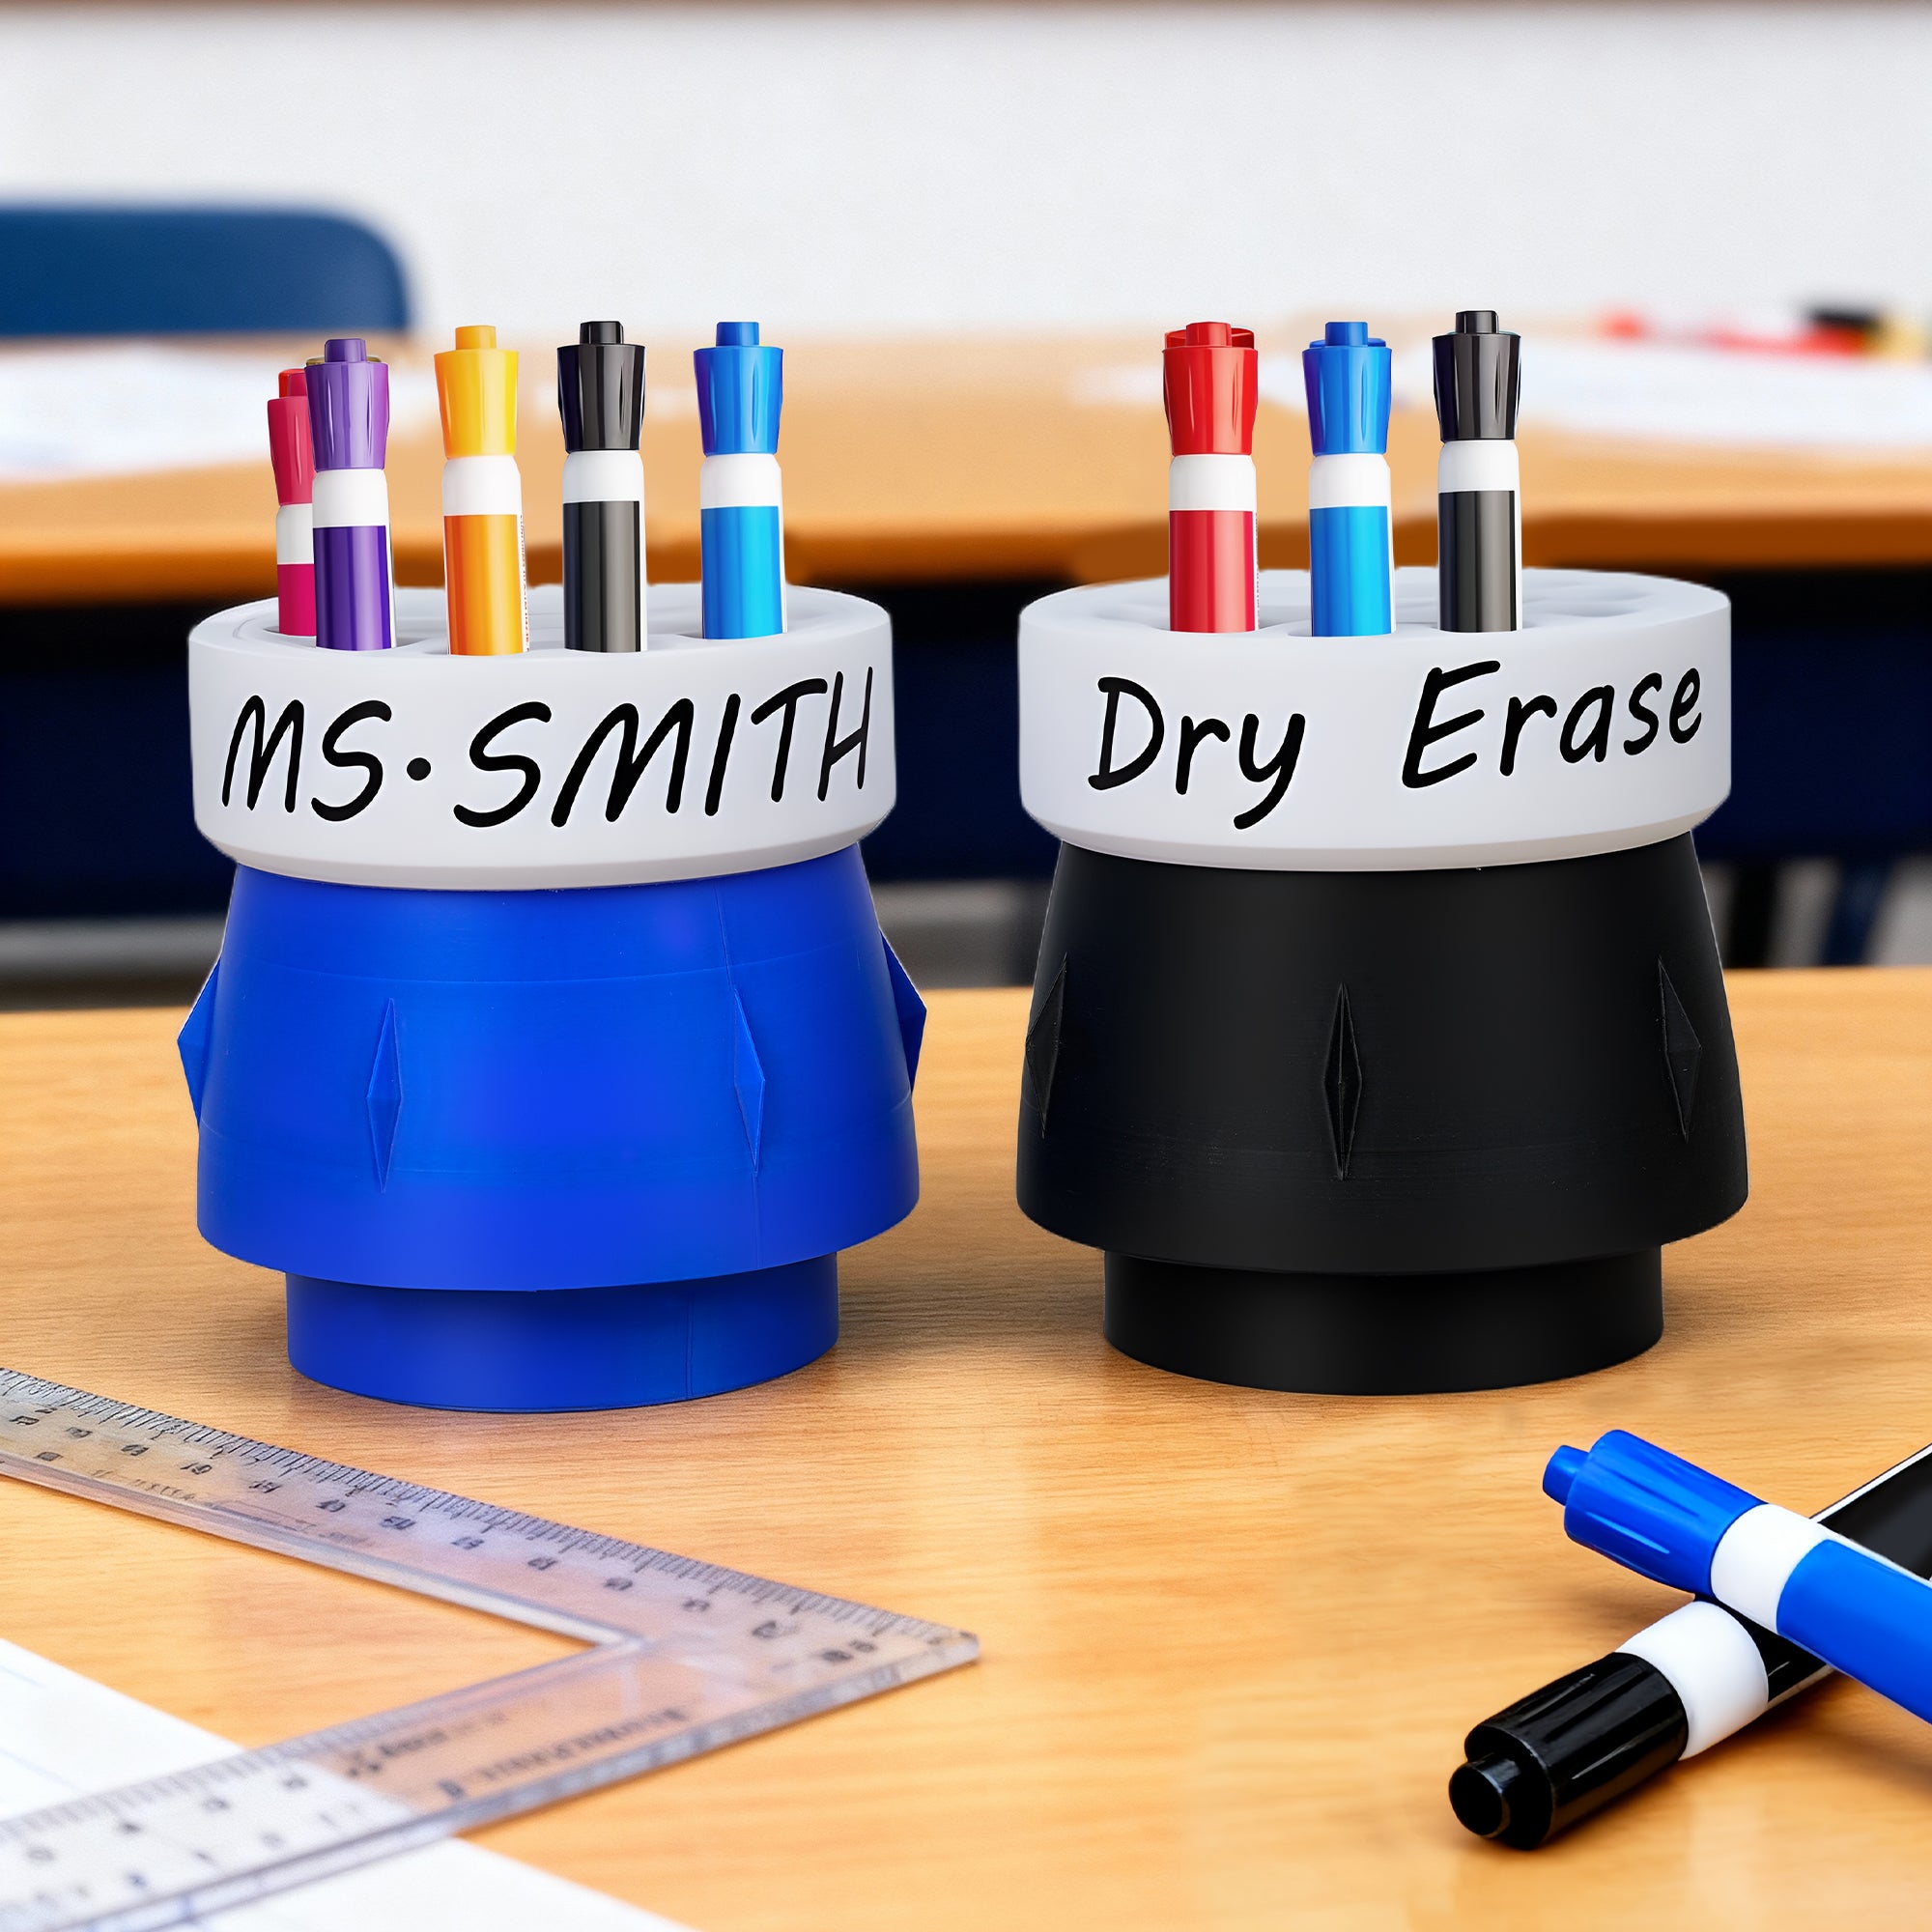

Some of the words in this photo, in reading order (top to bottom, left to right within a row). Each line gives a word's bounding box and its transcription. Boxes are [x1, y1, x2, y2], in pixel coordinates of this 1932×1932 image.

[453, 666, 873, 828] SMITH
[1088, 676, 1306, 830] Dry
[1403, 660, 1702, 789] Erase
